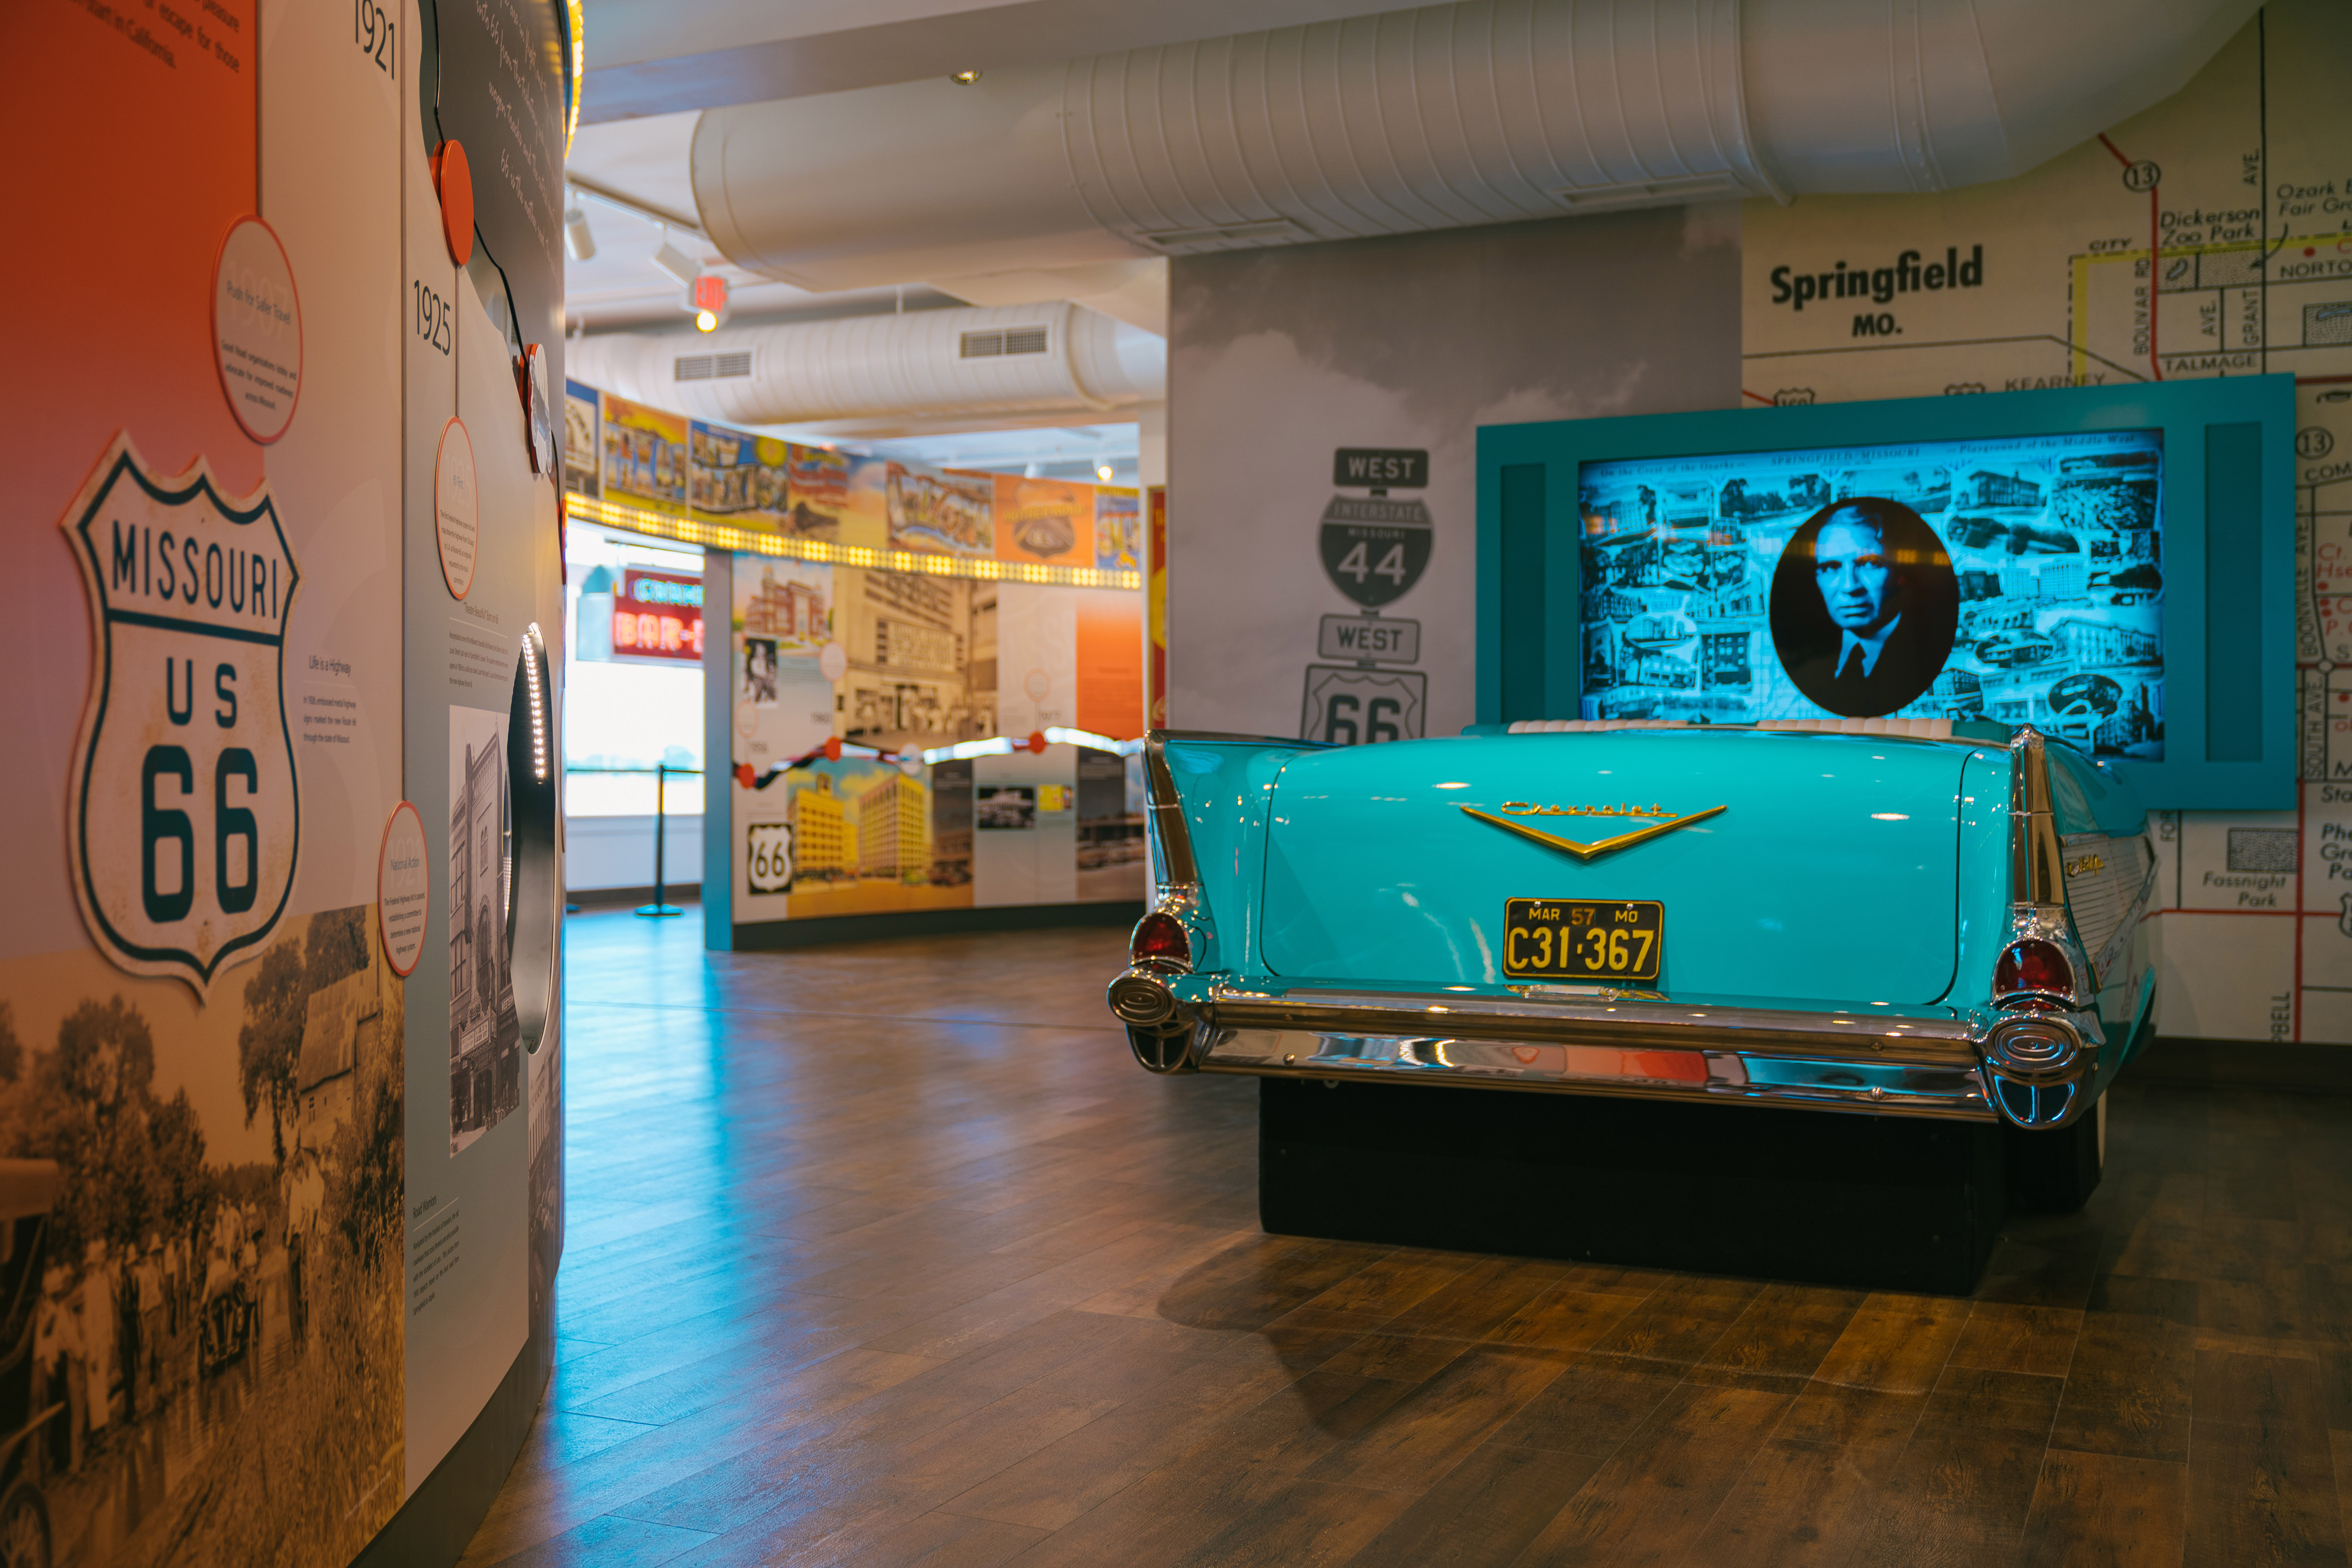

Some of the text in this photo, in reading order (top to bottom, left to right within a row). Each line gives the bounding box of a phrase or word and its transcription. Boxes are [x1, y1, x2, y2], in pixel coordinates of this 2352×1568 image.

[355, 0, 394, 81] 1921
[490, 13, 499, 45] 66
[500, 28, 513, 71] from
[513, 58, 521, 88] the
[489, 80, 506, 118] wagon
[507, 102, 522, 147] tracks
[501, 148, 509, 178] 66
[511, 165, 515, 188] is
[2132, 166, 2154, 186] 13
[2277, 180, 2335, 199] Ozark
[2160, 207, 2261, 229] Dickerson
[2278, 199, 2315, 217] Fair
[2089, 238, 2133, 253] CITY
[2162, 222, 2255, 247] Zoo Park
[1770, 244, 1983, 311] Springfield
[414, 279, 451, 356] 1925
[1852, 313, 1903, 337] MO.
[2133, 286, 2150, 356] BOLIVAR
[2242, 290, 2259, 346] GRANT
[2165, 352, 2257, 373] TALMAGE
[1960, 439, 2021, 454] Playground
[2064, 434, 2102, 446] Middle
[2108, 433, 2135, 444] West
[2302, 433, 2327, 454] 13
[1348, 457, 1416, 479] WEST
[1334, 502, 1423, 521] INTERSTATE
[1347, 526, 1406, 540] MISSOURI
[113, 520, 278, 619] MISSOURI
[1337, 541, 1406, 586] 44
[1337, 624, 1403, 652] WEST
[309, 655, 351, 677] Life is a Highway
[166, 657, 238, 729] US
[1325, 694, 1401, 744] 66
[2307, 720, 2323, 778] SOUTH
[1501, 801, 1678, 818] Chevrolet
[141, 744, 258, 923] 66
[391, 856, 420, 871] National Action
[756, 841, 786, 878] 66
[2203, 871, 2287, 890] Fassnight
[2237, 891, 2277, 908] Park
[1528, 907, 1638, 926] MAR 57 MO
[413, 1196, 437, 1219] Road Warriors
